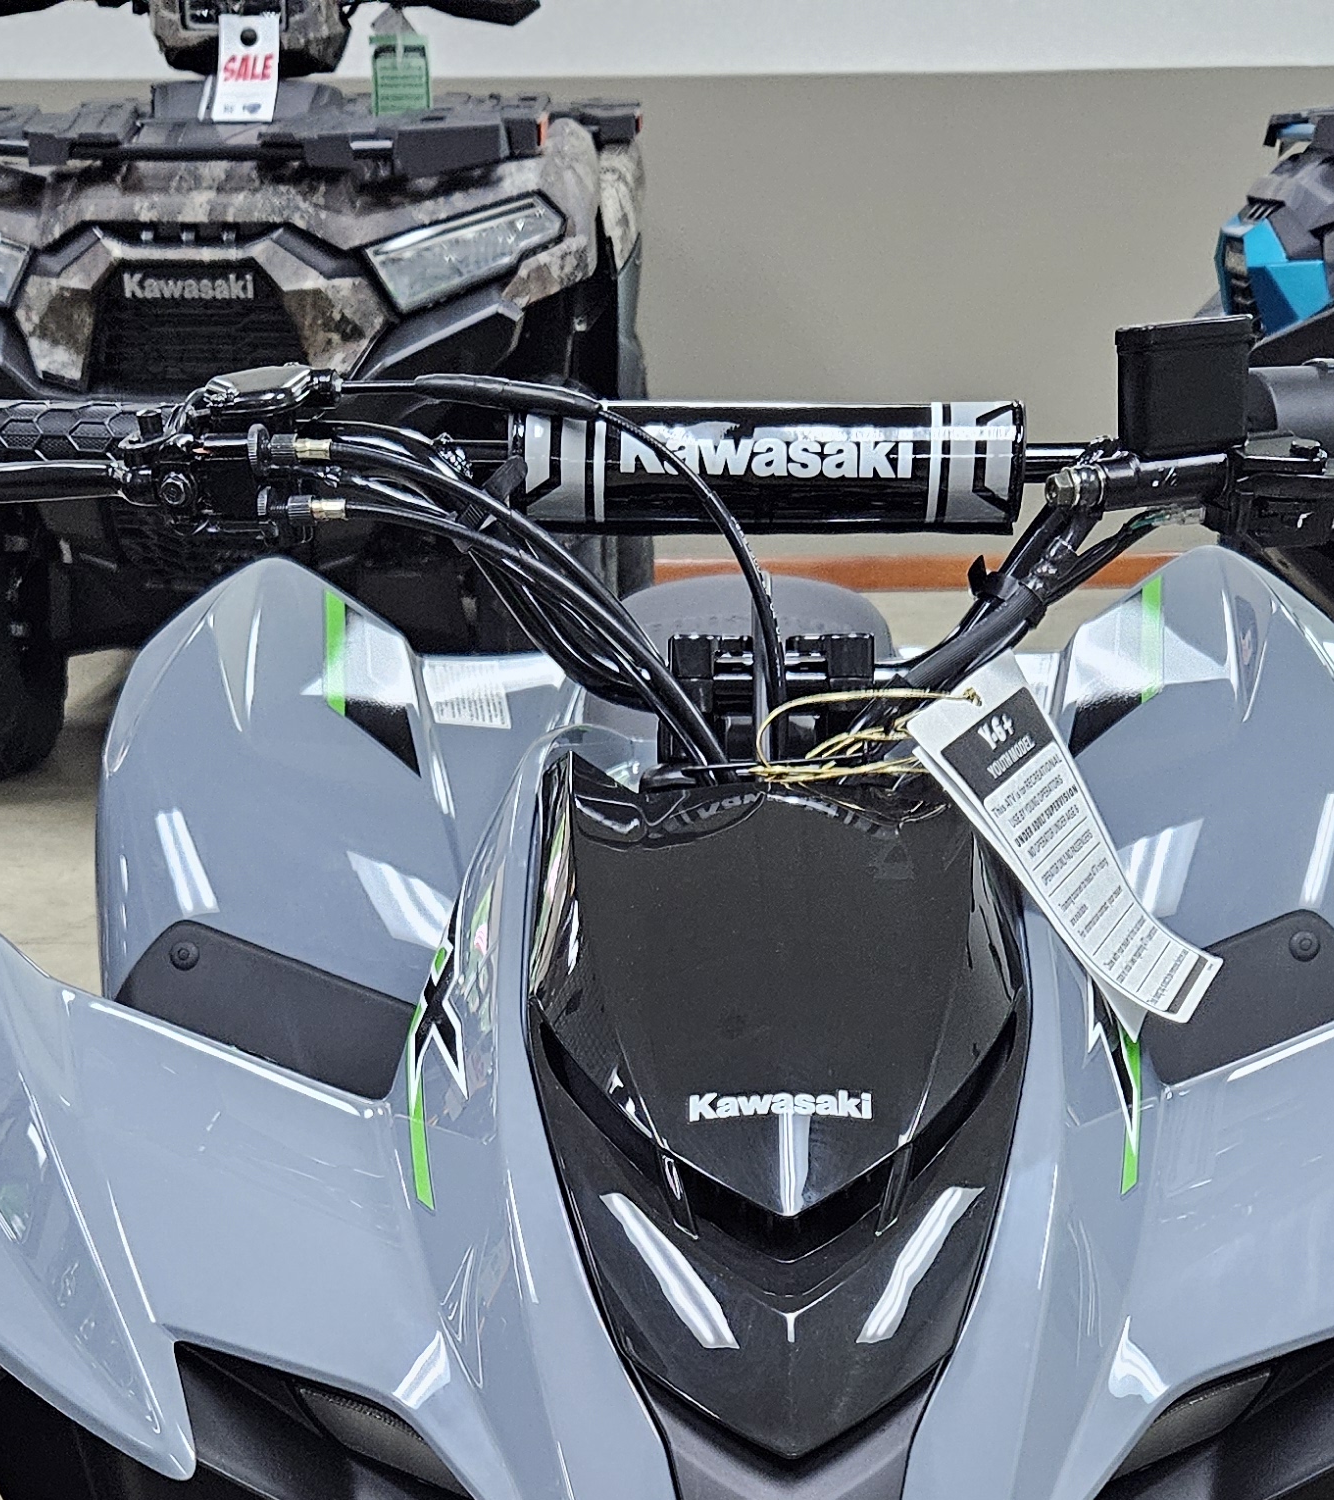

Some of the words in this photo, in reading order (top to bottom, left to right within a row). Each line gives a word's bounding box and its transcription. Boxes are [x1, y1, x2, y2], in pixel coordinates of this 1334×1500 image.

[224, 53, 273, 81] SALE
[123, 273, 255, 299] Kawasaki
[619, 437, 915, 479] Kawasaki
[986, 752, 1013, 778] YOUTH
[1007, 734, 1035, 761] MODEL
[1014, 826, 1033, 847] UNDER
[1030, 813, 1047, 831] ADULT
[1043, 785, 1078, 818] SUPERVISION
[688, 1090, 873, 1122] Kawasaki
